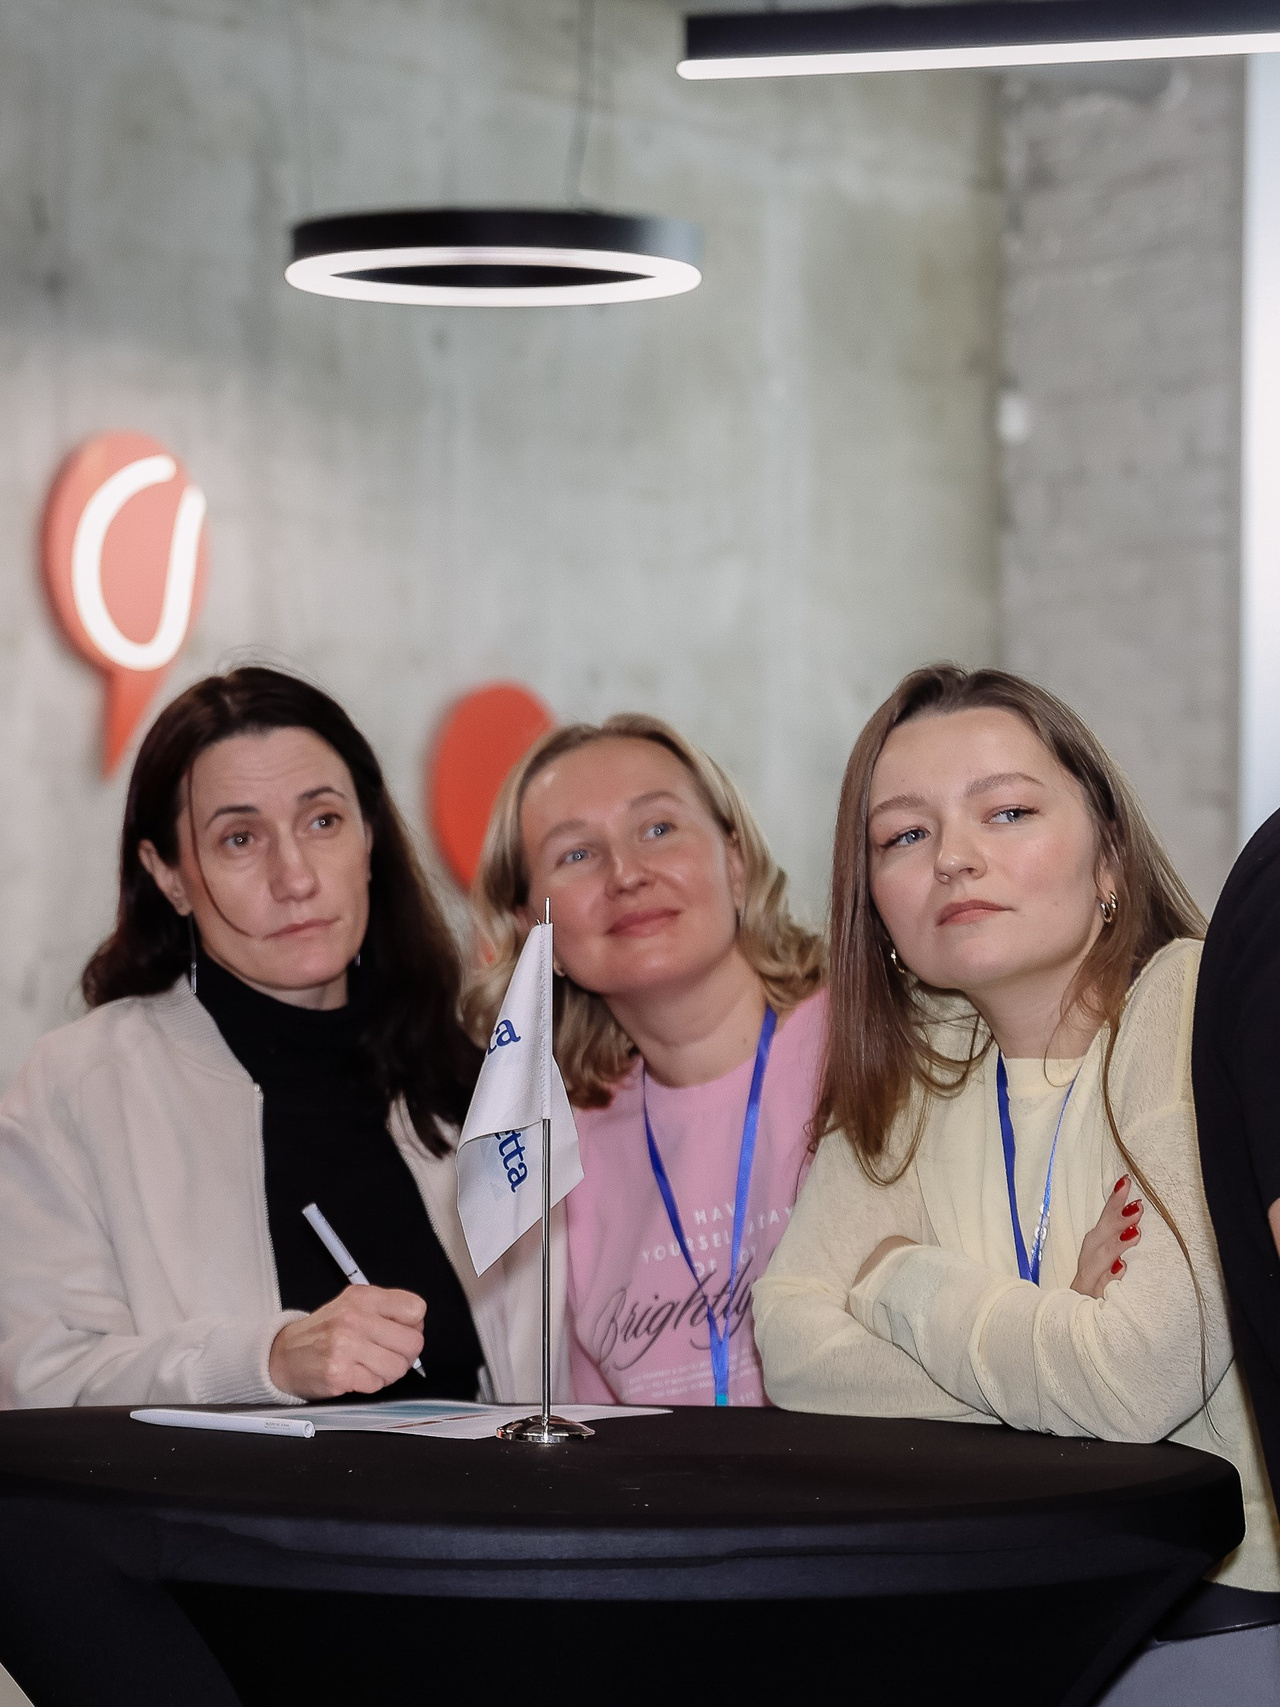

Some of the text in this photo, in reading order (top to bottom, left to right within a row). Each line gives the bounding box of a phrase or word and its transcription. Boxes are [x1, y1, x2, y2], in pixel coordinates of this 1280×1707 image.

[494, 1130, 528, 1193] tta
[693, 1202, 735, 1225] HAV
[642, 1230, 732, 1264] YOURSEL
[592, 1257, 757, 1371] Brightly
